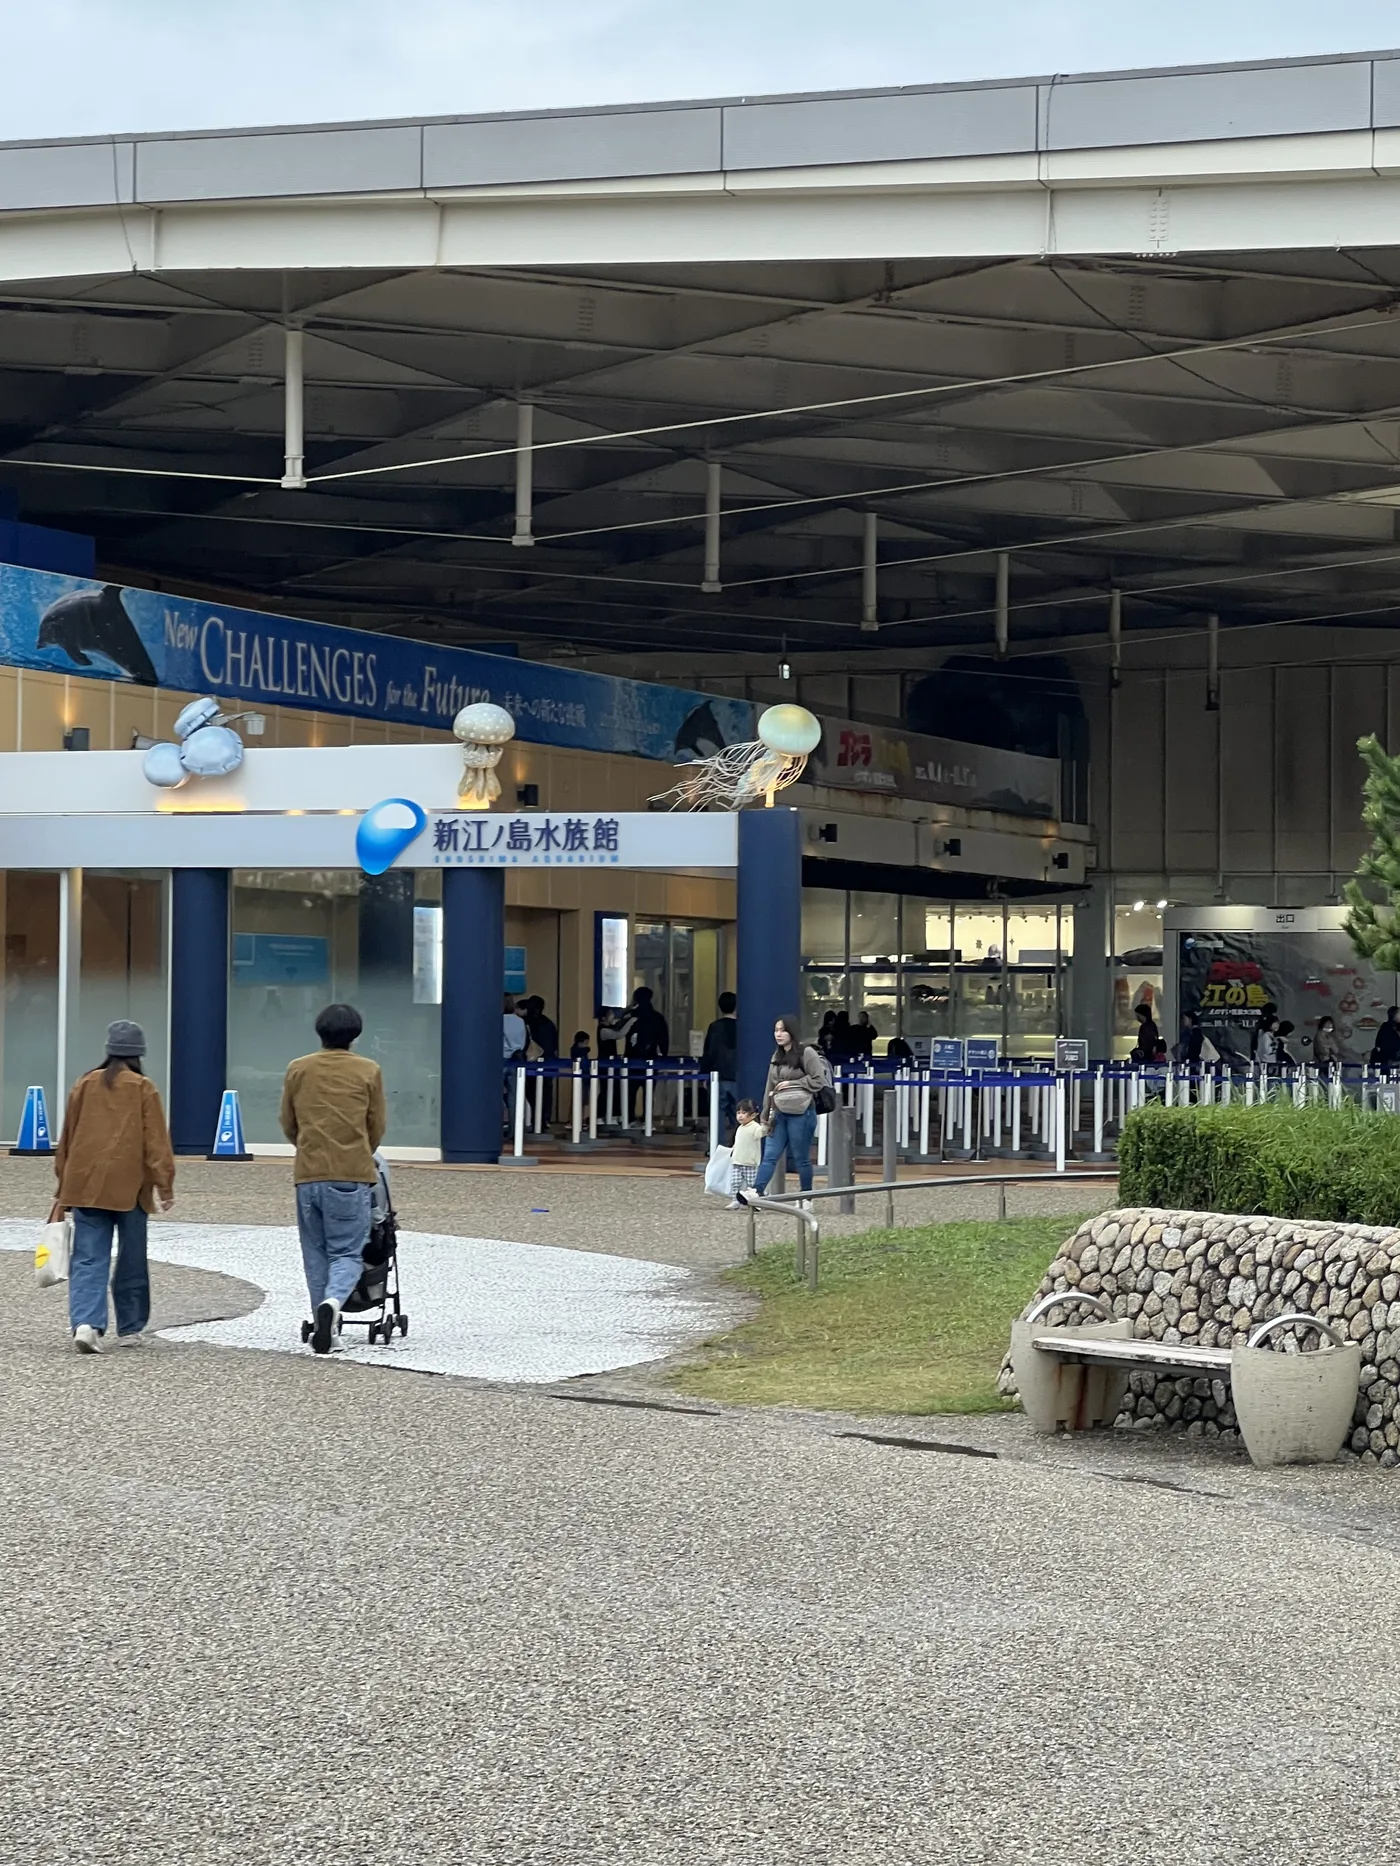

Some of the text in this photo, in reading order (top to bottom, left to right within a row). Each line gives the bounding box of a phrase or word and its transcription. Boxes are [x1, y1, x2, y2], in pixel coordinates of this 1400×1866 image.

[164, 609, 198, 650] New
[201, 617, 377, 706] CHALLENGES
[433, 818, 619, 851] 新江ノ島水族館
[1200, 984, 1269, 1008] 江の島
